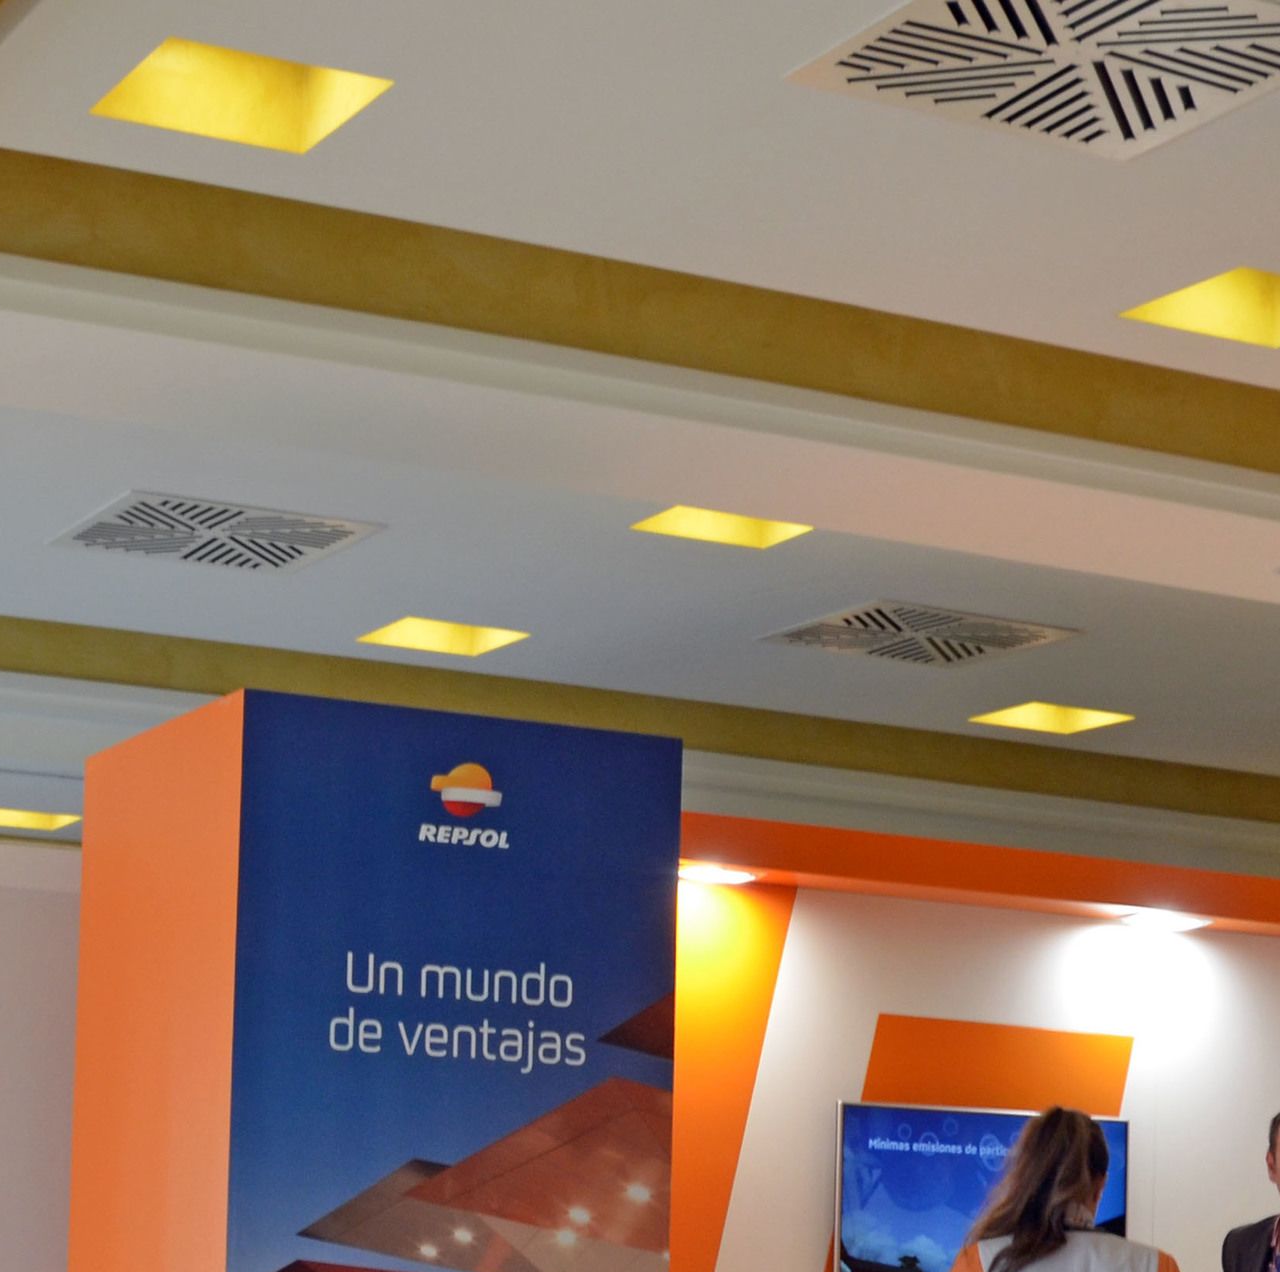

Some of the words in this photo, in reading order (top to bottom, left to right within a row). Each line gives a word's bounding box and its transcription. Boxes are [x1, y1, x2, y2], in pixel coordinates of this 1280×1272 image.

[418, 823, 510, 850] REPSOL
[346, 951, 404, 997] Un
[420, 963, 573, 1009] mundo
[329, 1006, 382, 1054] de
[398, 1019, 586, 1074] ventajas
[912, 1141, 963, 1155] emisiones
[965, 1144, 977, 1155] de
